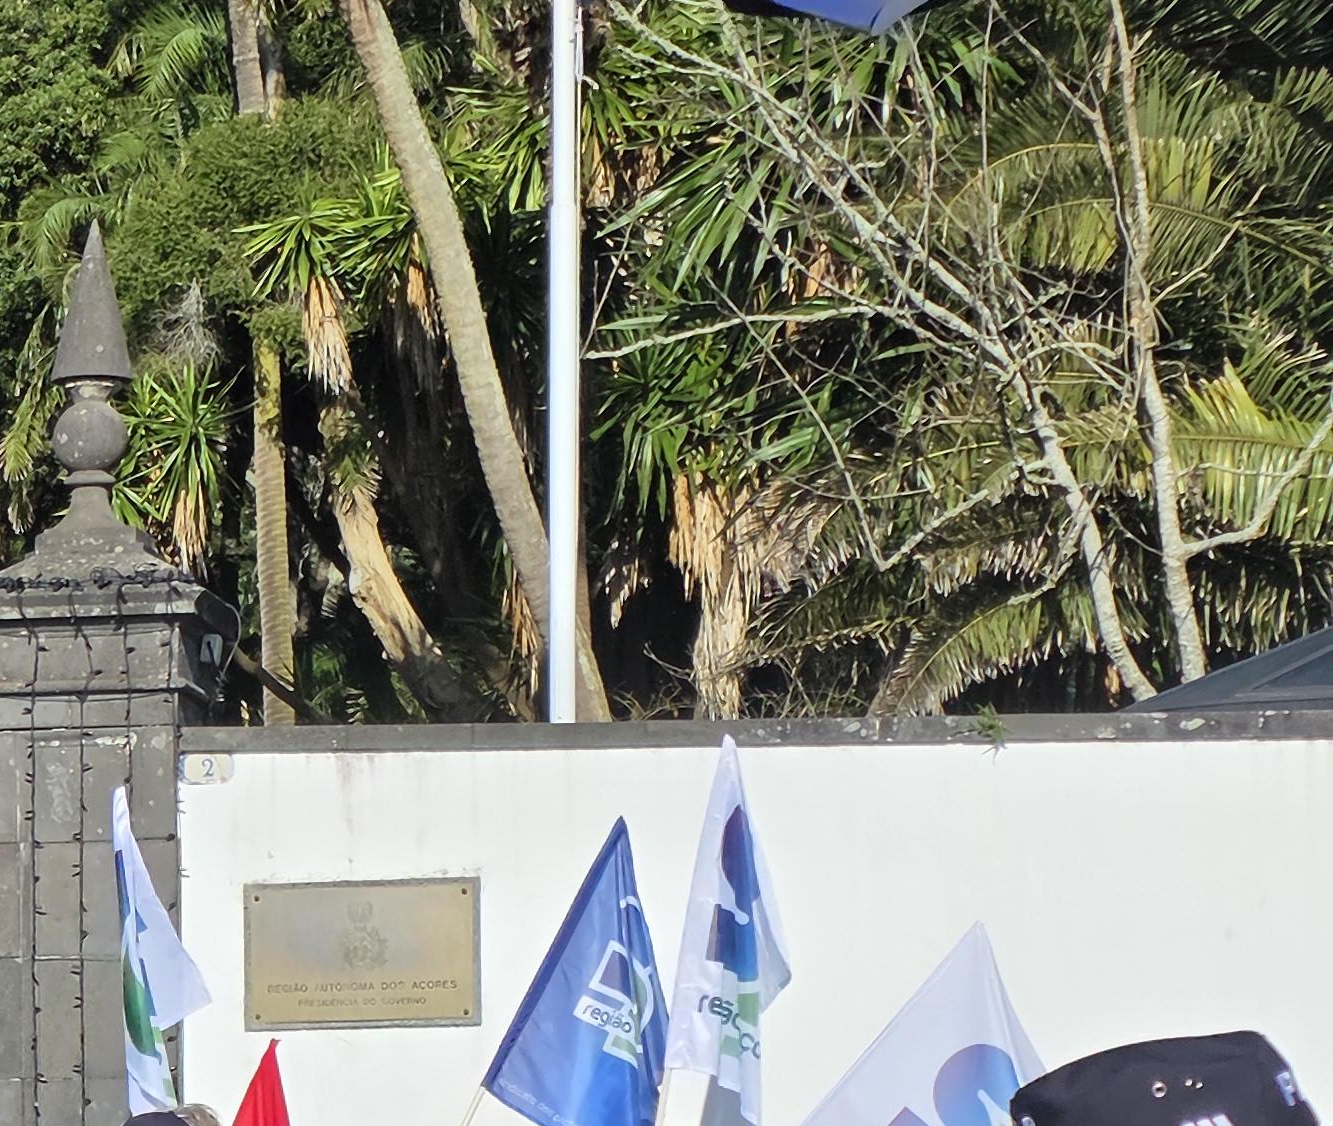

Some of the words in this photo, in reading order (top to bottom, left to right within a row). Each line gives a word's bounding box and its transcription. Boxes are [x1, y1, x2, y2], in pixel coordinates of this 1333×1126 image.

[201, 758, 214, 777] 2
[268, 982, 308, 994] REGIÃO
[412, 979, 458, 991] AÇORES
[363, 997, 377, 1006] DO
[383, 996, 427, 1006] GOVERNO
[582, 1003, 632, 1034] região
